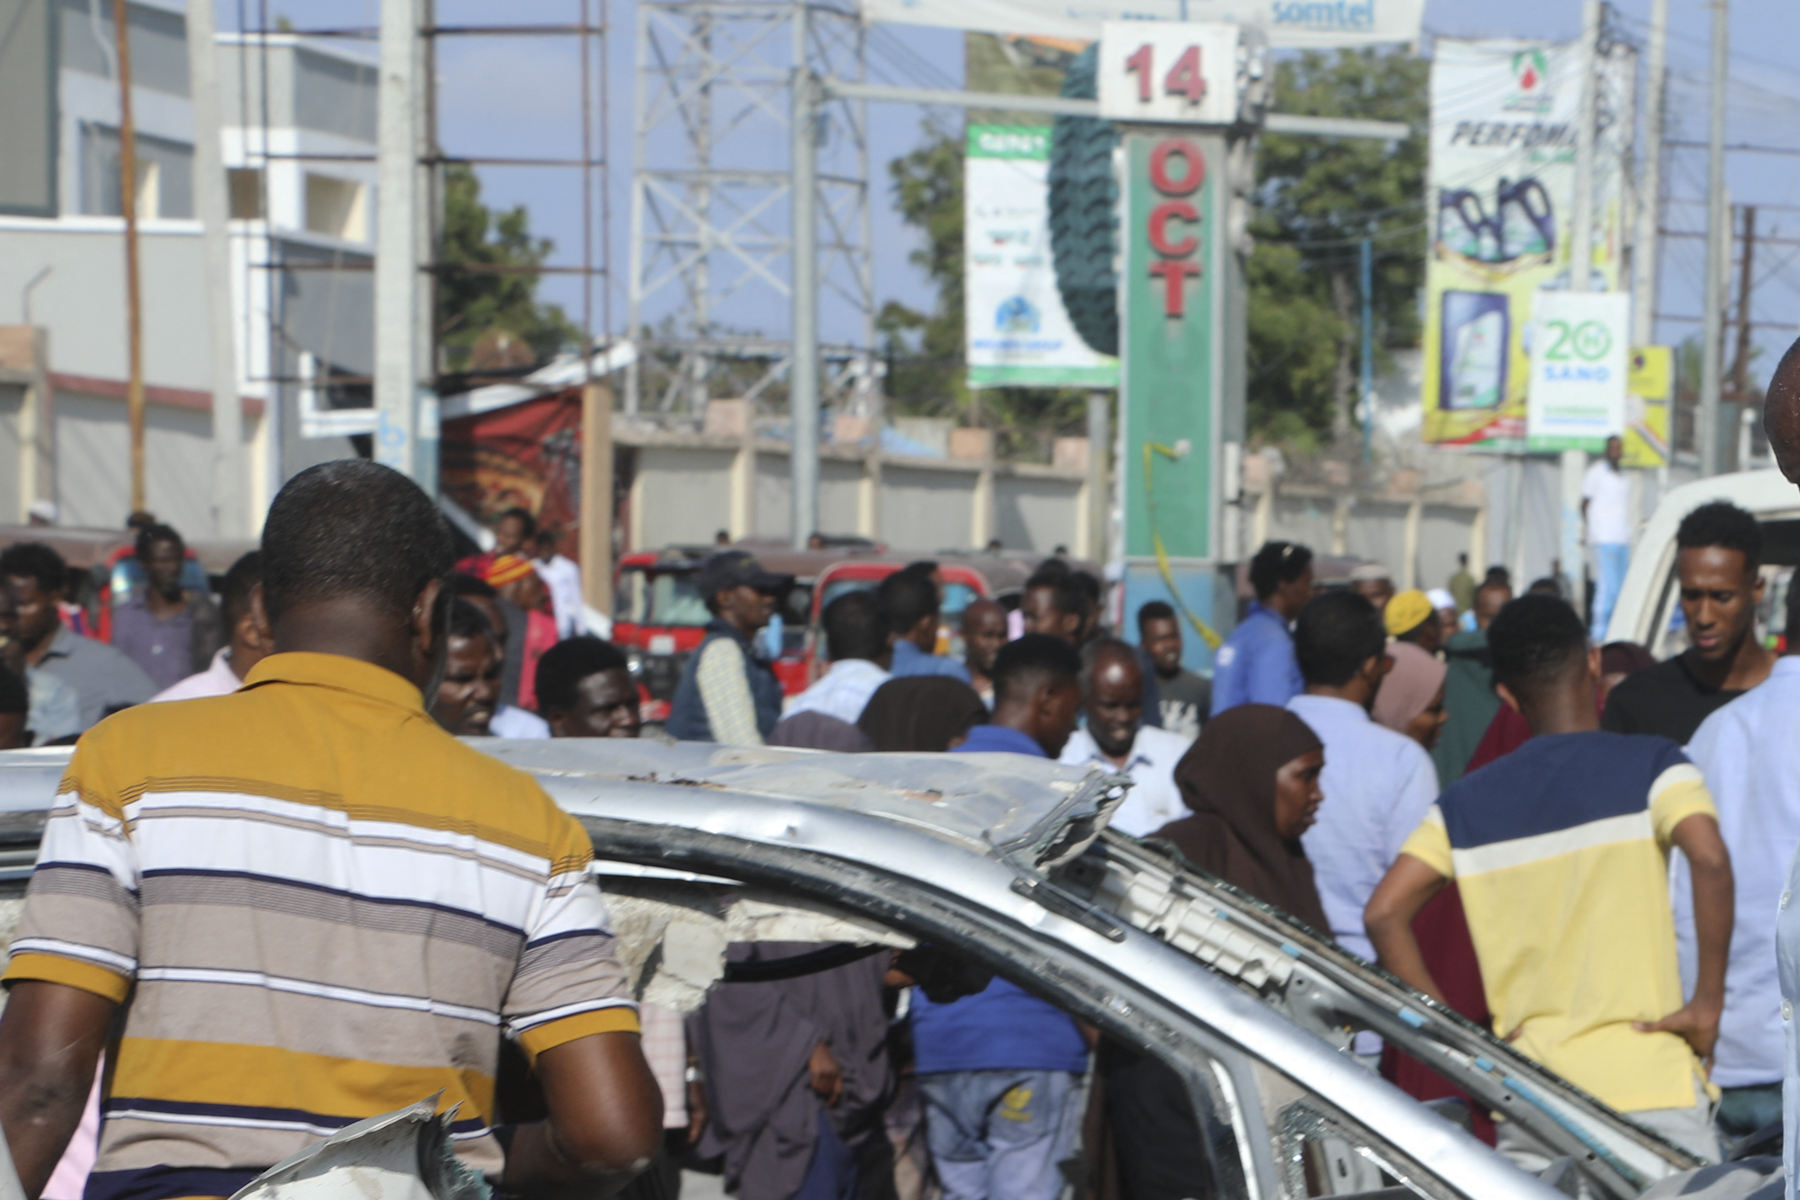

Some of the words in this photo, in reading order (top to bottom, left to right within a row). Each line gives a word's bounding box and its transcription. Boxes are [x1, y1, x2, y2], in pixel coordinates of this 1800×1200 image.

[1272, 0, 1375, 25] somtel
[1125, 43, 1208, 105] 14
[1147, 138, 1205, 318] OCT
[1544, 318, 1613, 362] 20
[1544, 366, 1611, 382] SANO
